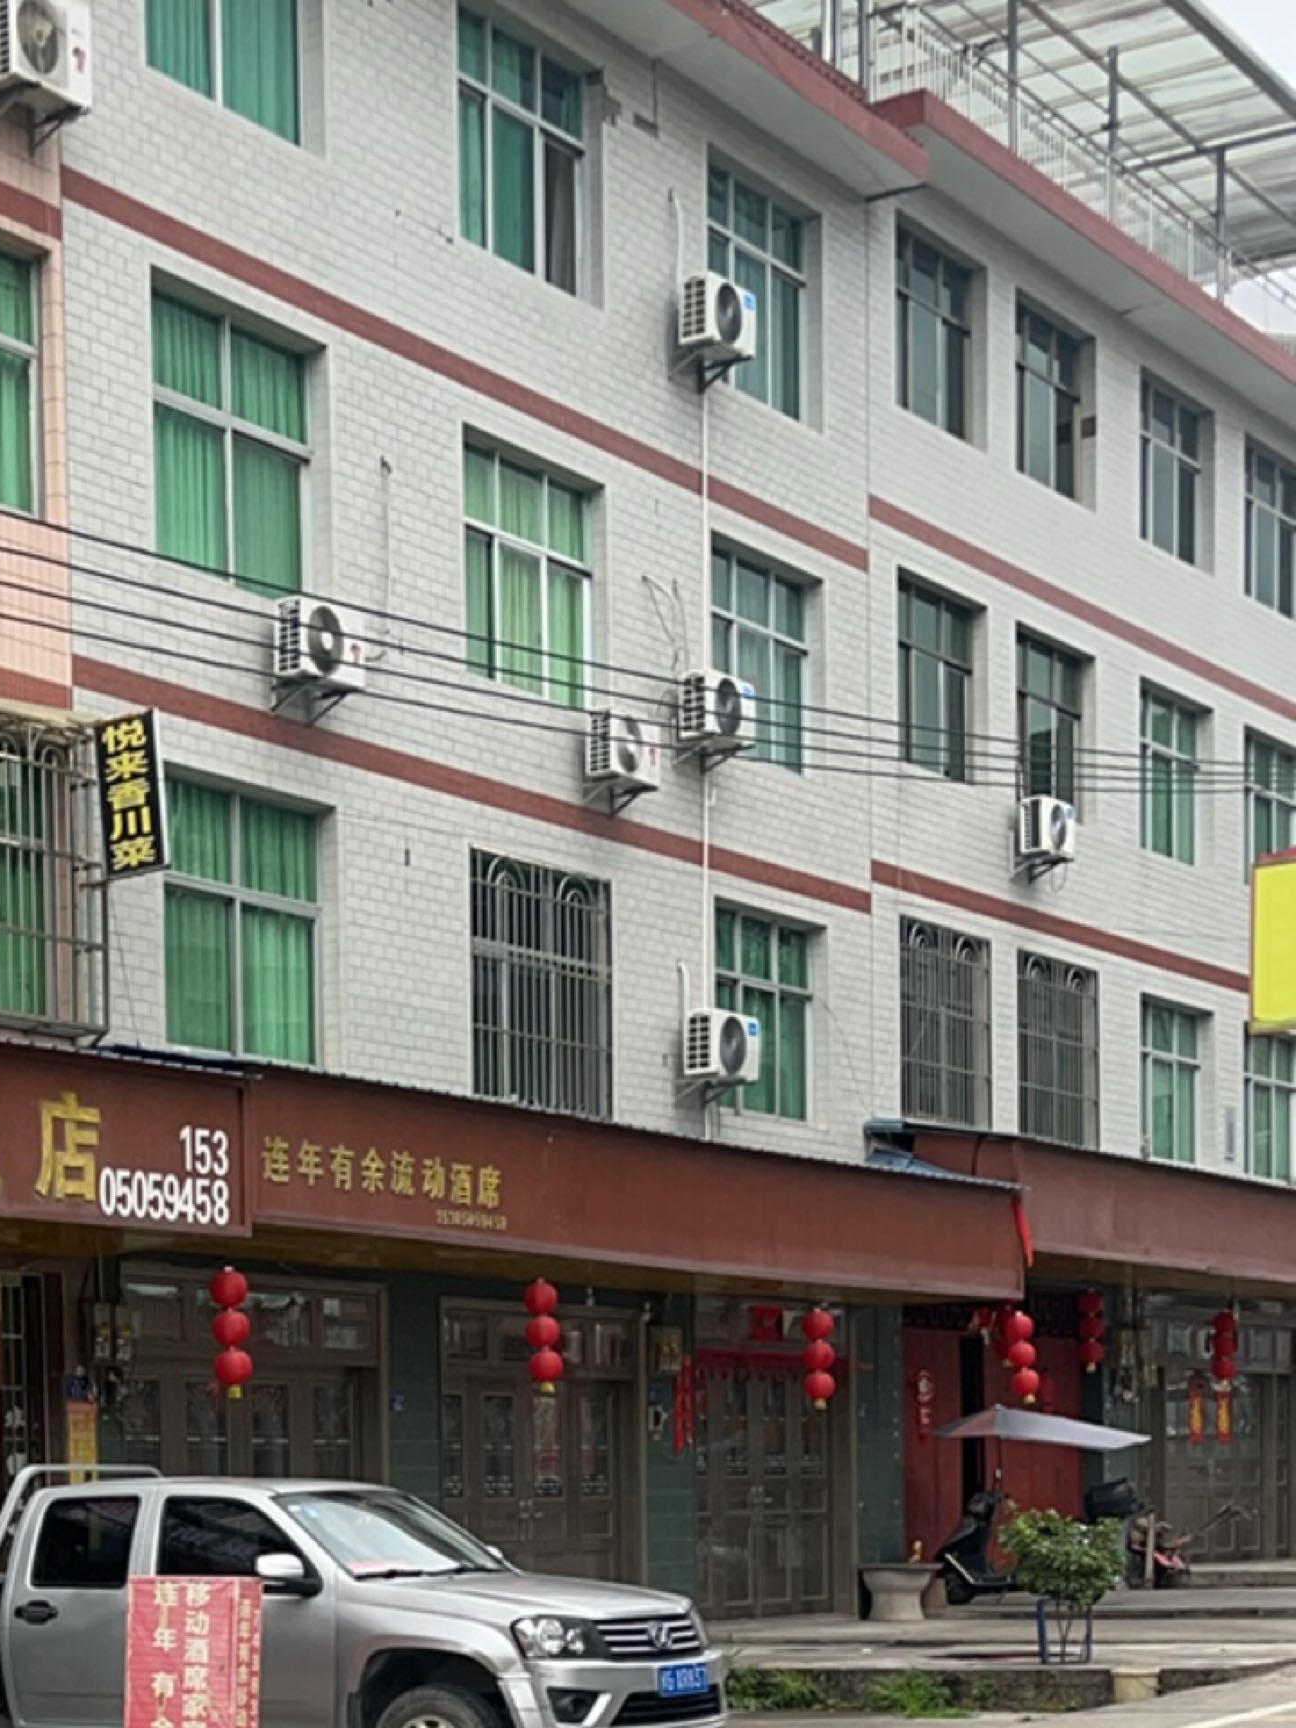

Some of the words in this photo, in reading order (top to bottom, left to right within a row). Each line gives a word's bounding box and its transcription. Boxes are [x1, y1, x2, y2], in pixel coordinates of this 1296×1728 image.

[179, 1124, 230, 1174] 153
[261, 1136, 502, 1209] 连年有余流动酒席
[100, 1167, 230, 1226] 05059458
